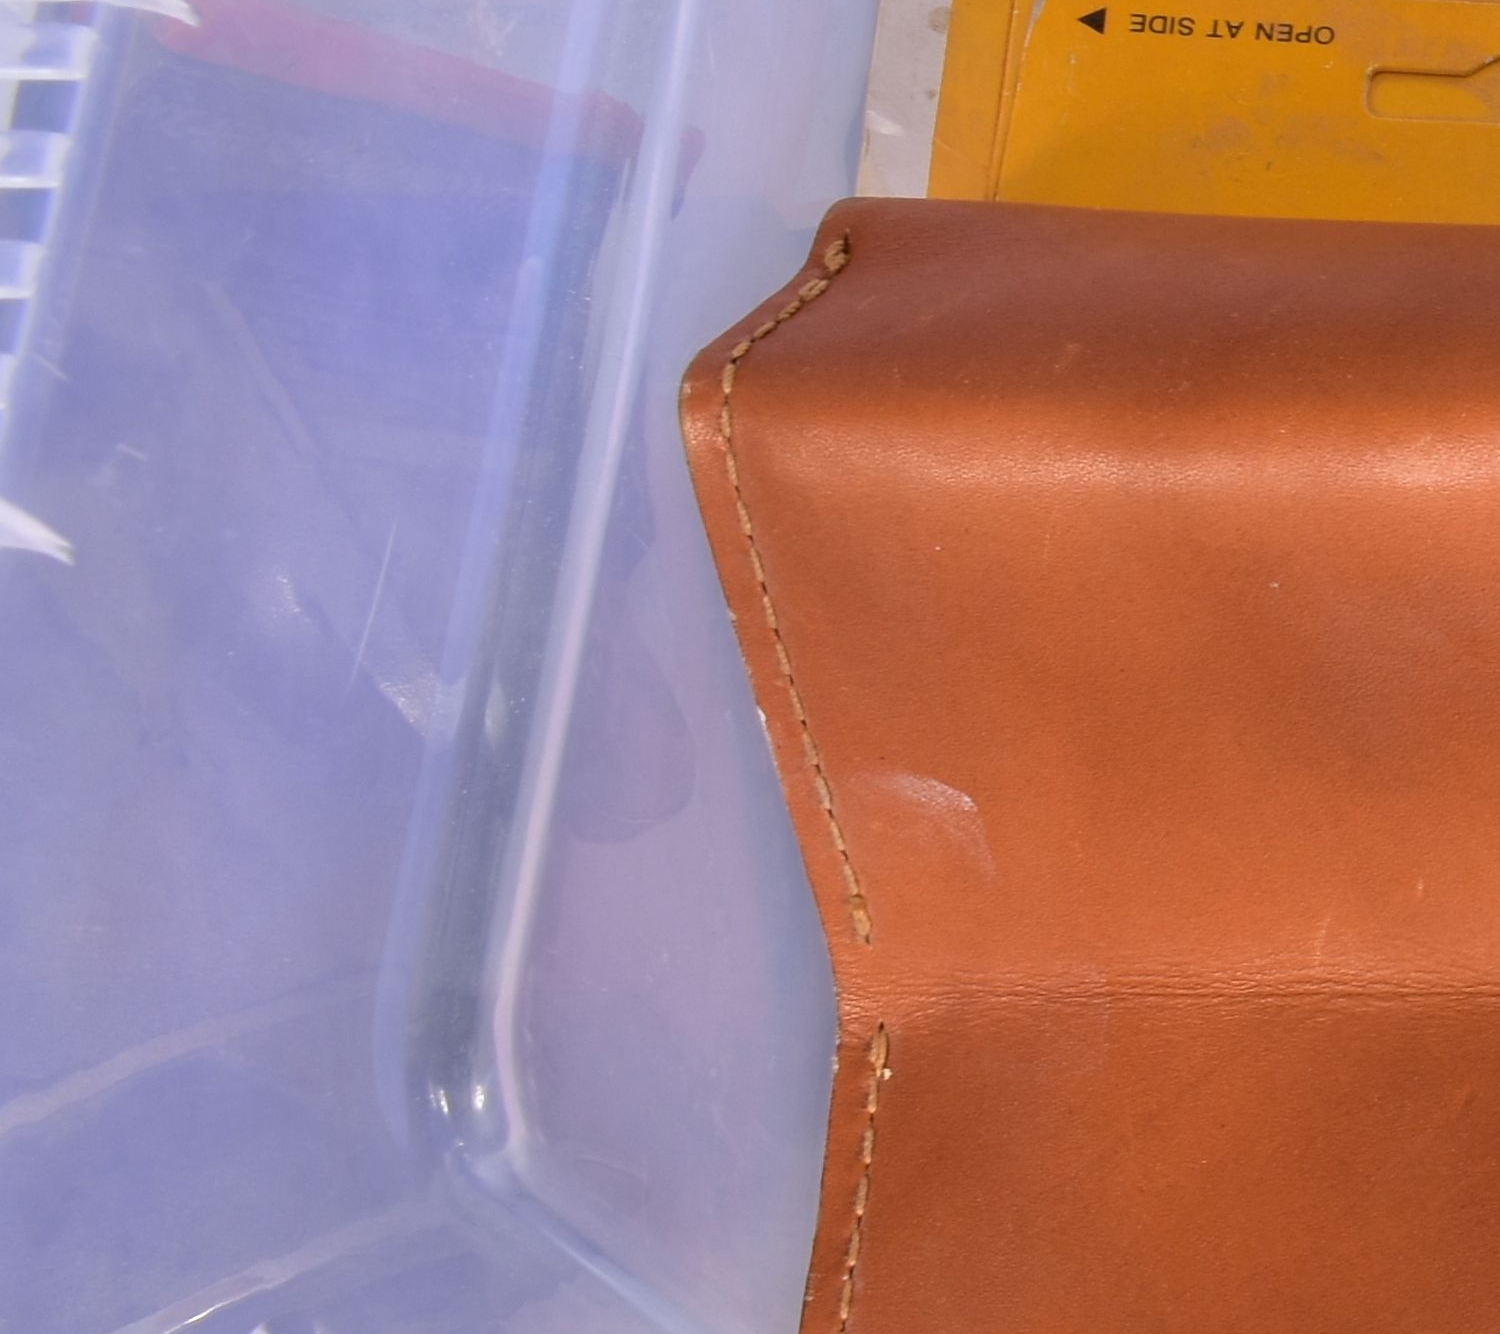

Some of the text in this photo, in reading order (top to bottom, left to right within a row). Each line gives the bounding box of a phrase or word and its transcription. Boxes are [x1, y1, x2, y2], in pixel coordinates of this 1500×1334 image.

[1127, 12, 1337, 47] OPEN AT SIDE
